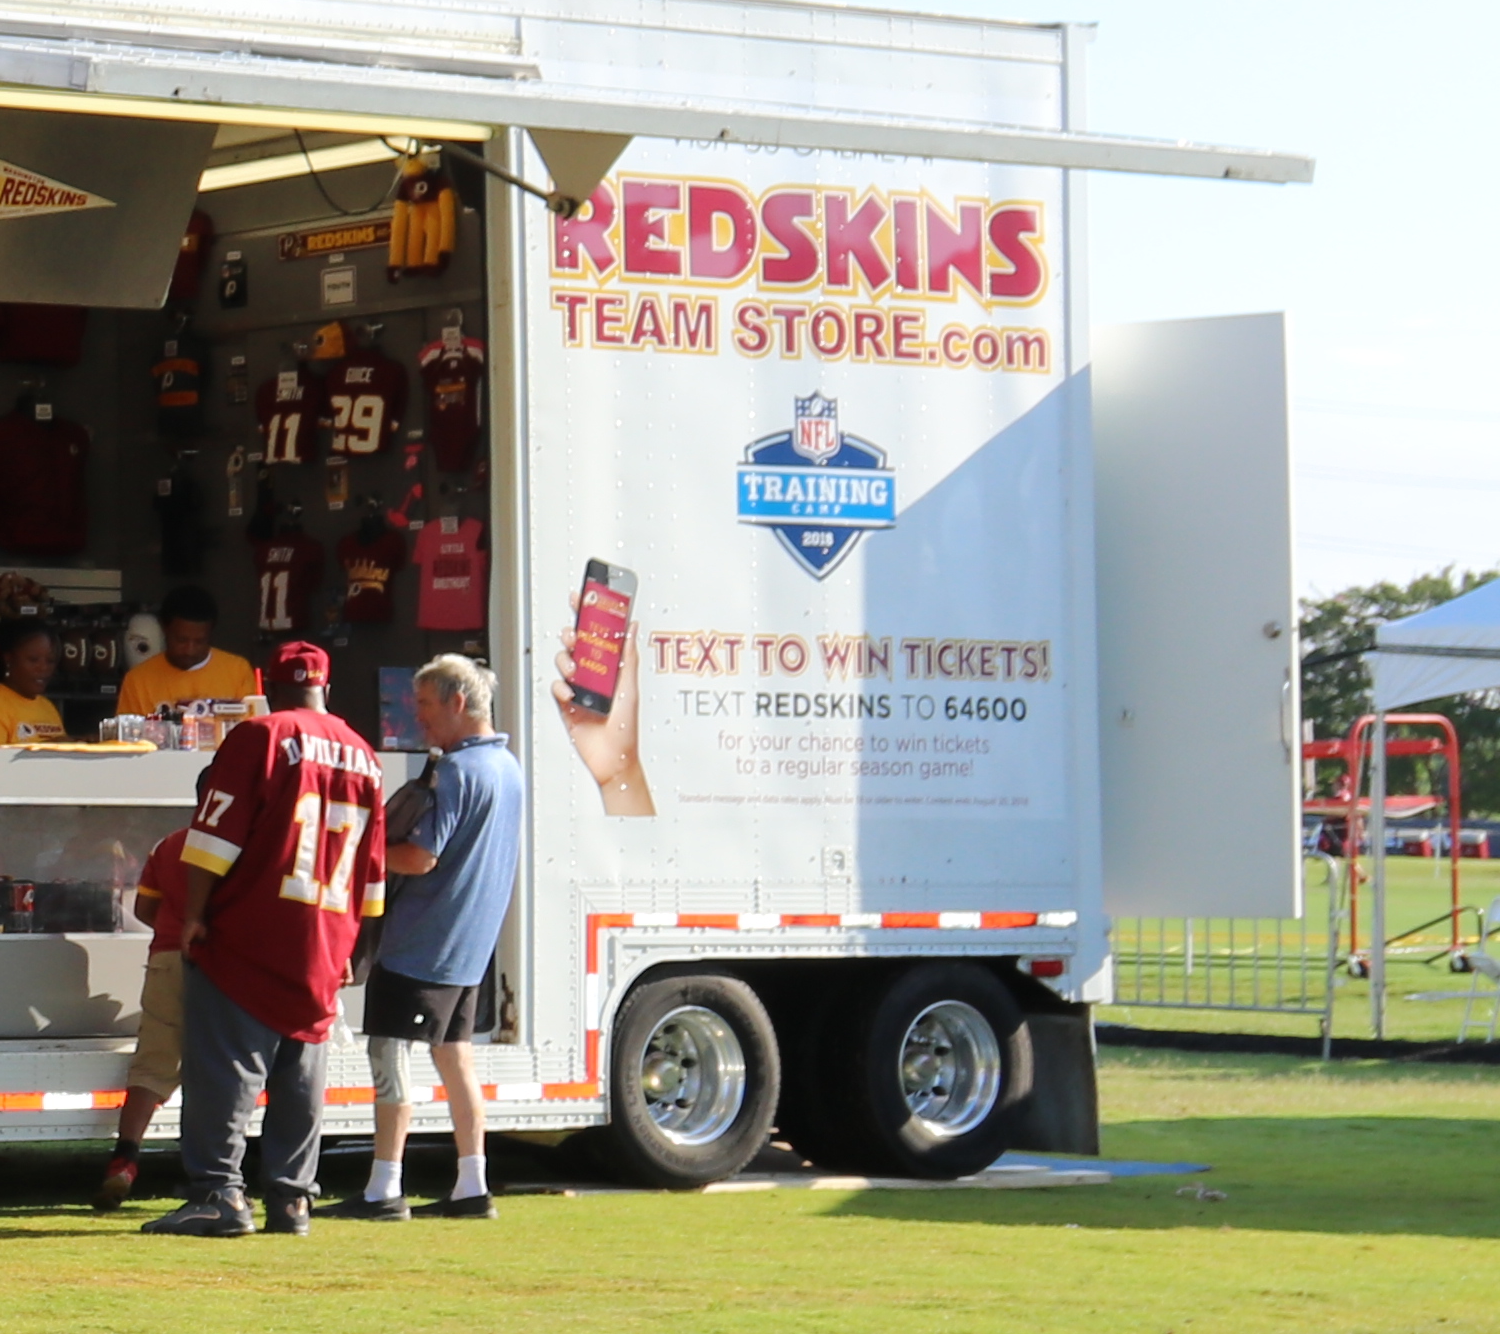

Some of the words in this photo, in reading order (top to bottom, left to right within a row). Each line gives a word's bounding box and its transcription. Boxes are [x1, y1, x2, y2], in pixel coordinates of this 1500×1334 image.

[307, 226, 375, 251] REDSKINS
[550, 172, 1048, 307] REDSKINS
[553, 291, 716, 351] TEAM
[734, 303, 1048, 370] STORE.com
[266, 412, 301, 464] 11
[330, 394, 384, 454] 29
[799, 419, 835, 451] NFL
[743, 474, 888, 506] TRAINING
[791, 503, 843, 515] CAMP
[259, 570, 293, 631] 11
[651, 633, 743, 674] TEXT
[753, 635, 809, 676] TO
[819, 634, 891, 679] WIN
[902, 639, 1051, 681] TICKETS!
[678, 690, 746, 717] TEXT
[755, 691, 891, 719] REDSKINS
[901, 694, 936, 721] TO
[944, 696, 1028, 722] 64600
[717, 730, 743, 750] for
[748, 735, 792, 756] your
[798, 731, 864, 752] chance
[870, 734, 889, 752] to
[896, 733, 927, 753] win
[932, 733, 991, 755] tickets
[736, 758, 754, 775] to
[760, 761, 772, 775] a
[777, 758, 845, 779] regular
[850, 761, 914, 777] season
[920, 759, 975, 779] game!
[197, 788, 235, 828] 17
[278, 791, 372, 914] 17
